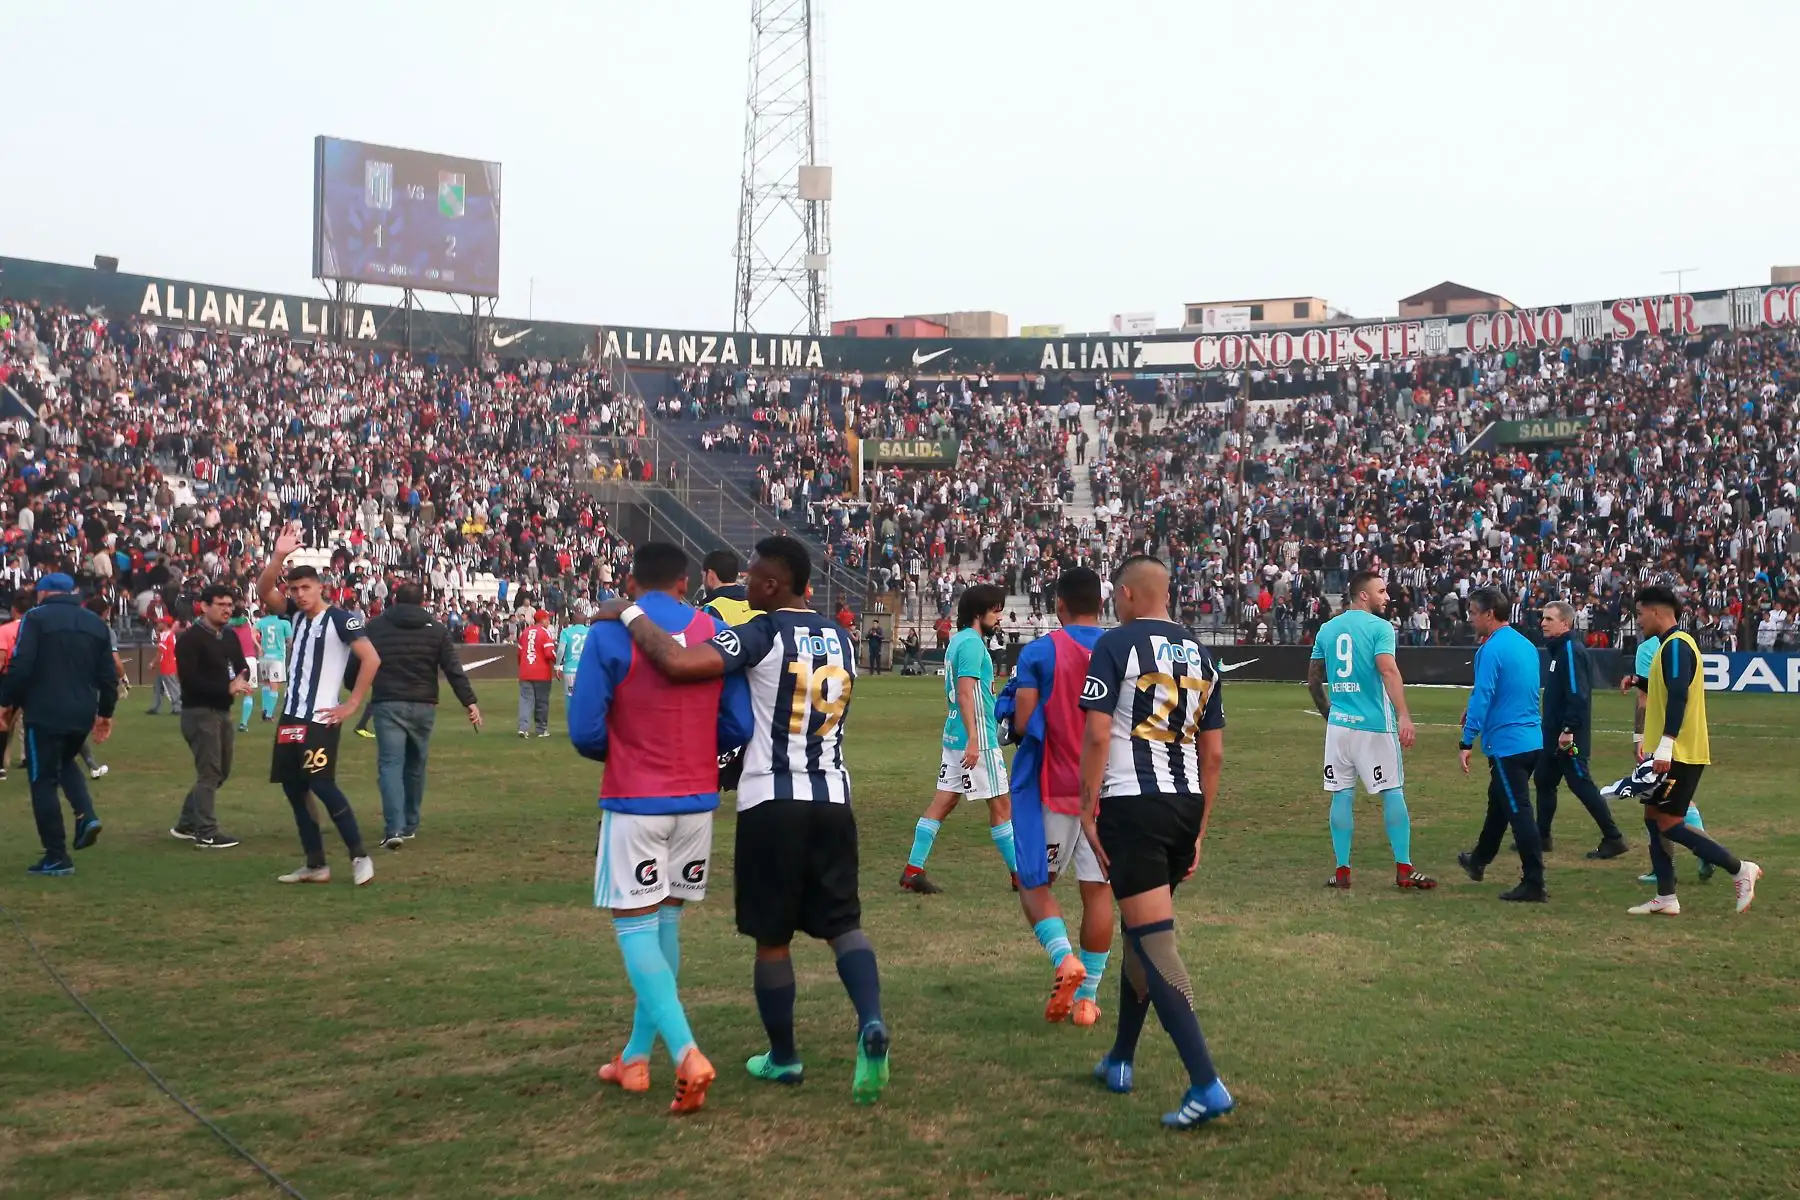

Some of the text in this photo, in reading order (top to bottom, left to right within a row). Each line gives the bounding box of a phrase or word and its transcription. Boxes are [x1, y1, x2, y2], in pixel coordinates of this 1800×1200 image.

[407, 184, 424, 200] VS
[374, 224, 382, 248] 1
[446, 235, 456, 258] 2
[139, 283, 289, 331] ALIANZA
[1466, 306, 1564, 354] CONO
[603, 330, 824, 368] ALIANZA LIMA
[1193, 321, 1422, 370] CONO OESTE
[1519, 421, 1582, 439] SALIDA
[879, 442, 943, 457] SALIDA
[267, 625, 275, 645] 5
[1336, 633, 1353, 678] 9
[788, 661, 851, 736] 19
[1331, 682, 1361, 693] HERRERA
[1130, 672, 1211, 744] 27
[303, 747, 328, 769] 26
